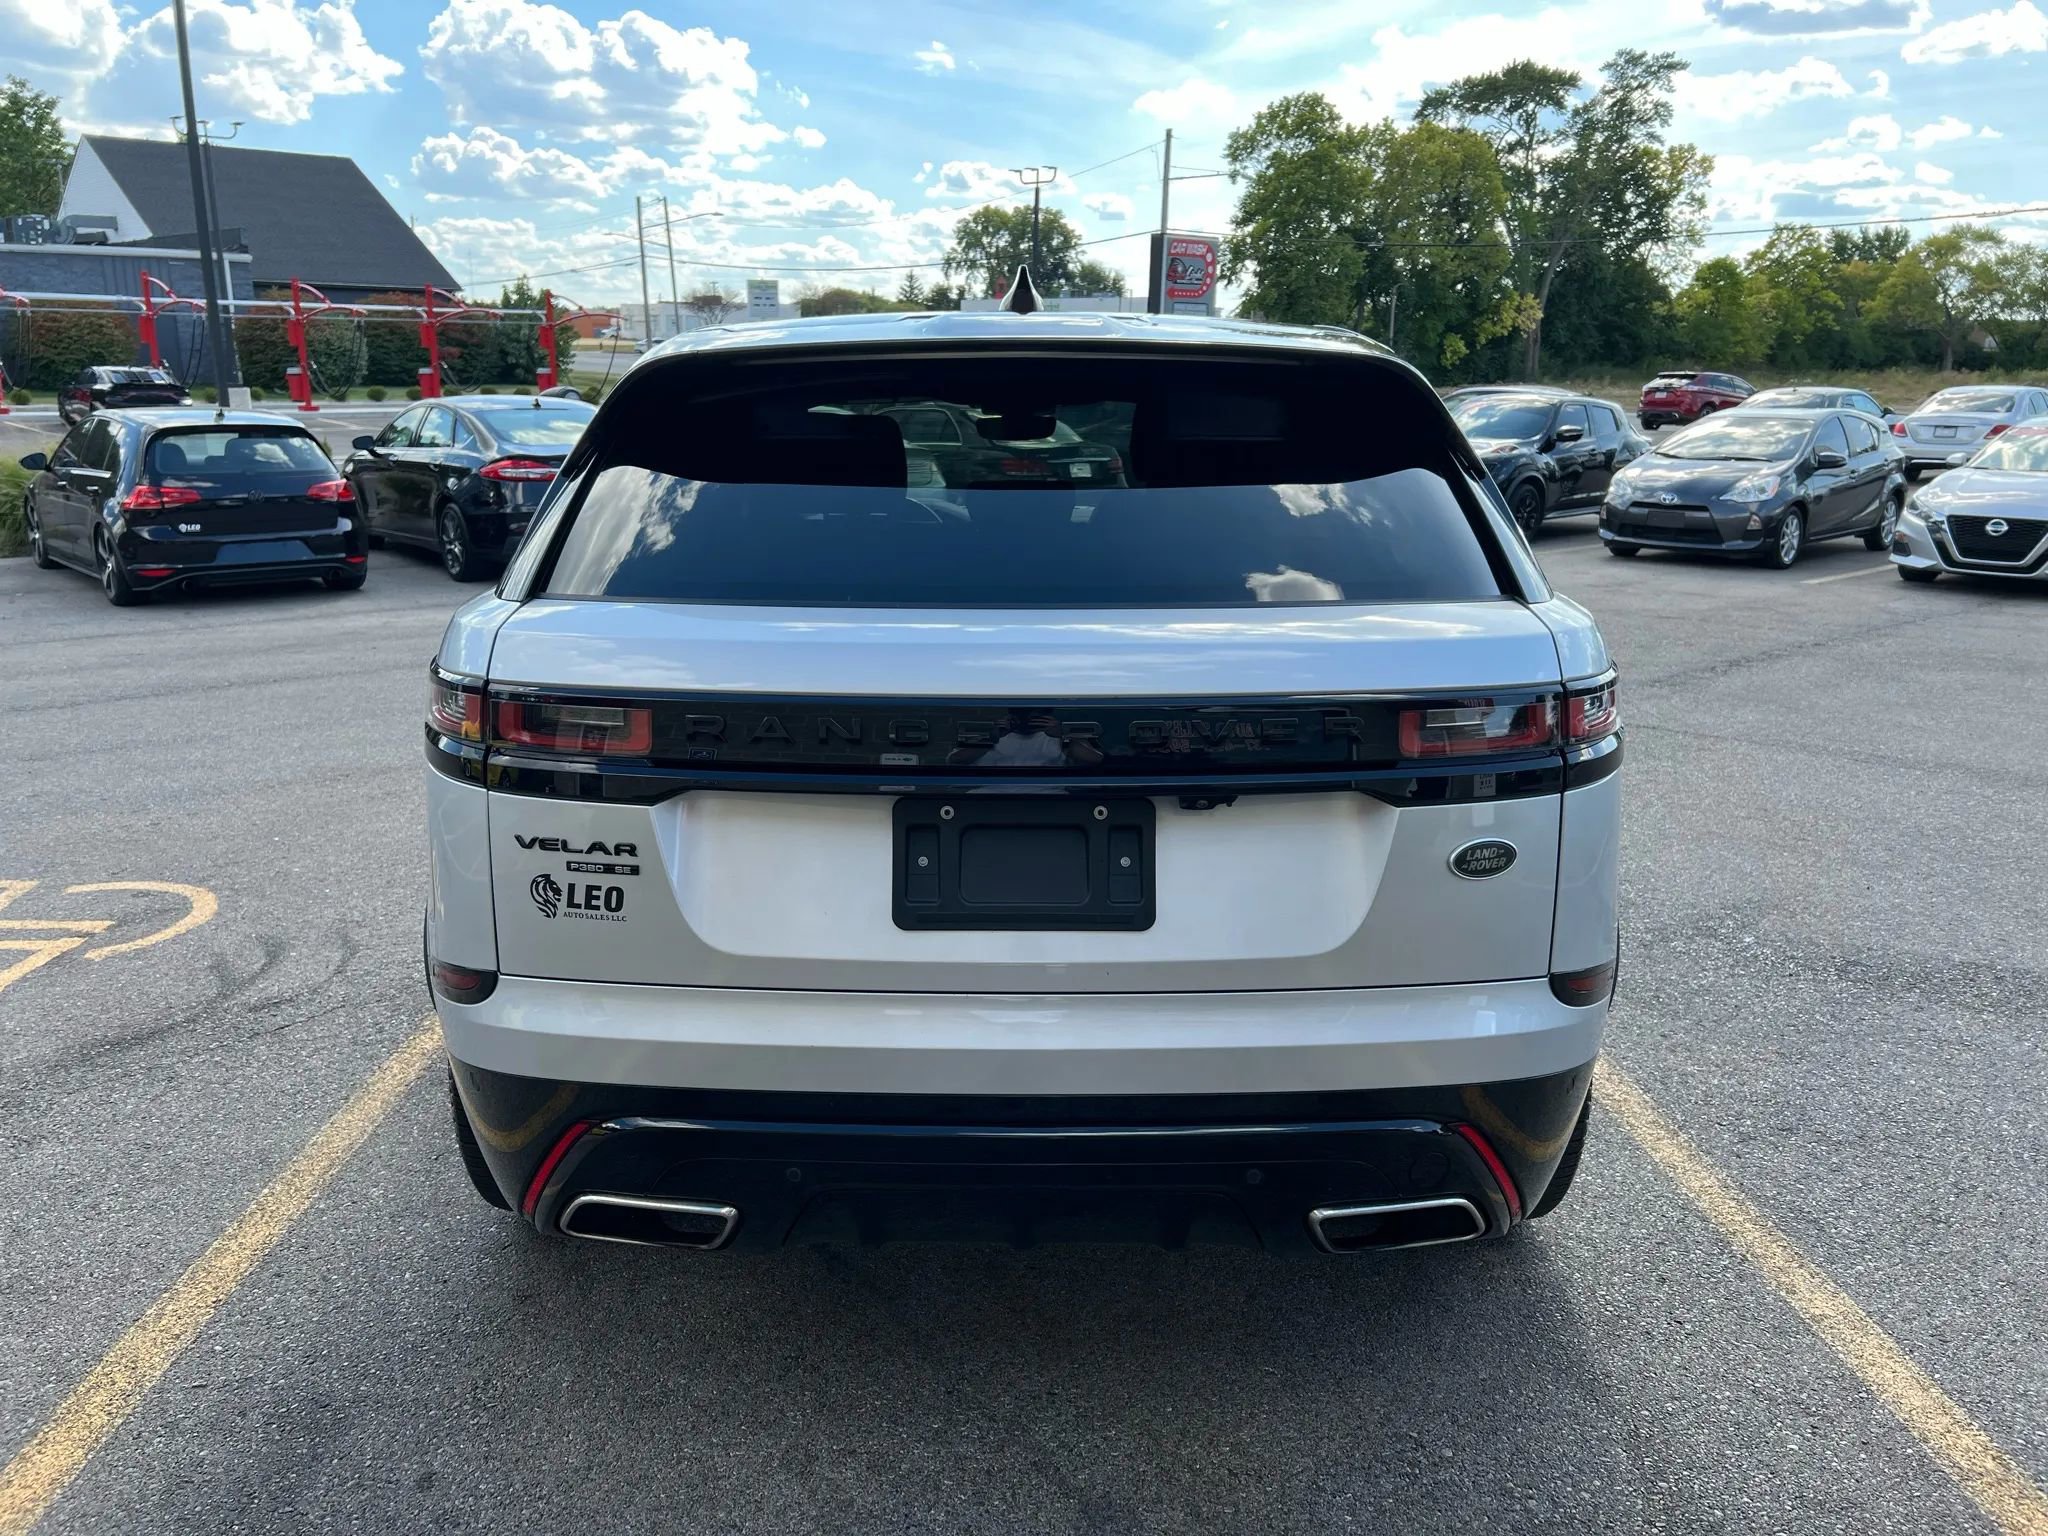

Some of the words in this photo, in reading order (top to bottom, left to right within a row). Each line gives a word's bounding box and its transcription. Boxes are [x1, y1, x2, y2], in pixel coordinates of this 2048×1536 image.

[685, 714, 996, 746] RANGE
[1061, 716, 1365, 744] ROVER
[514, 834, 639, 857] VELAR
[570, 863, 604, 874] P380
[614, 866, 632, 874] SE
[566, 883, 625, 913] LEO
